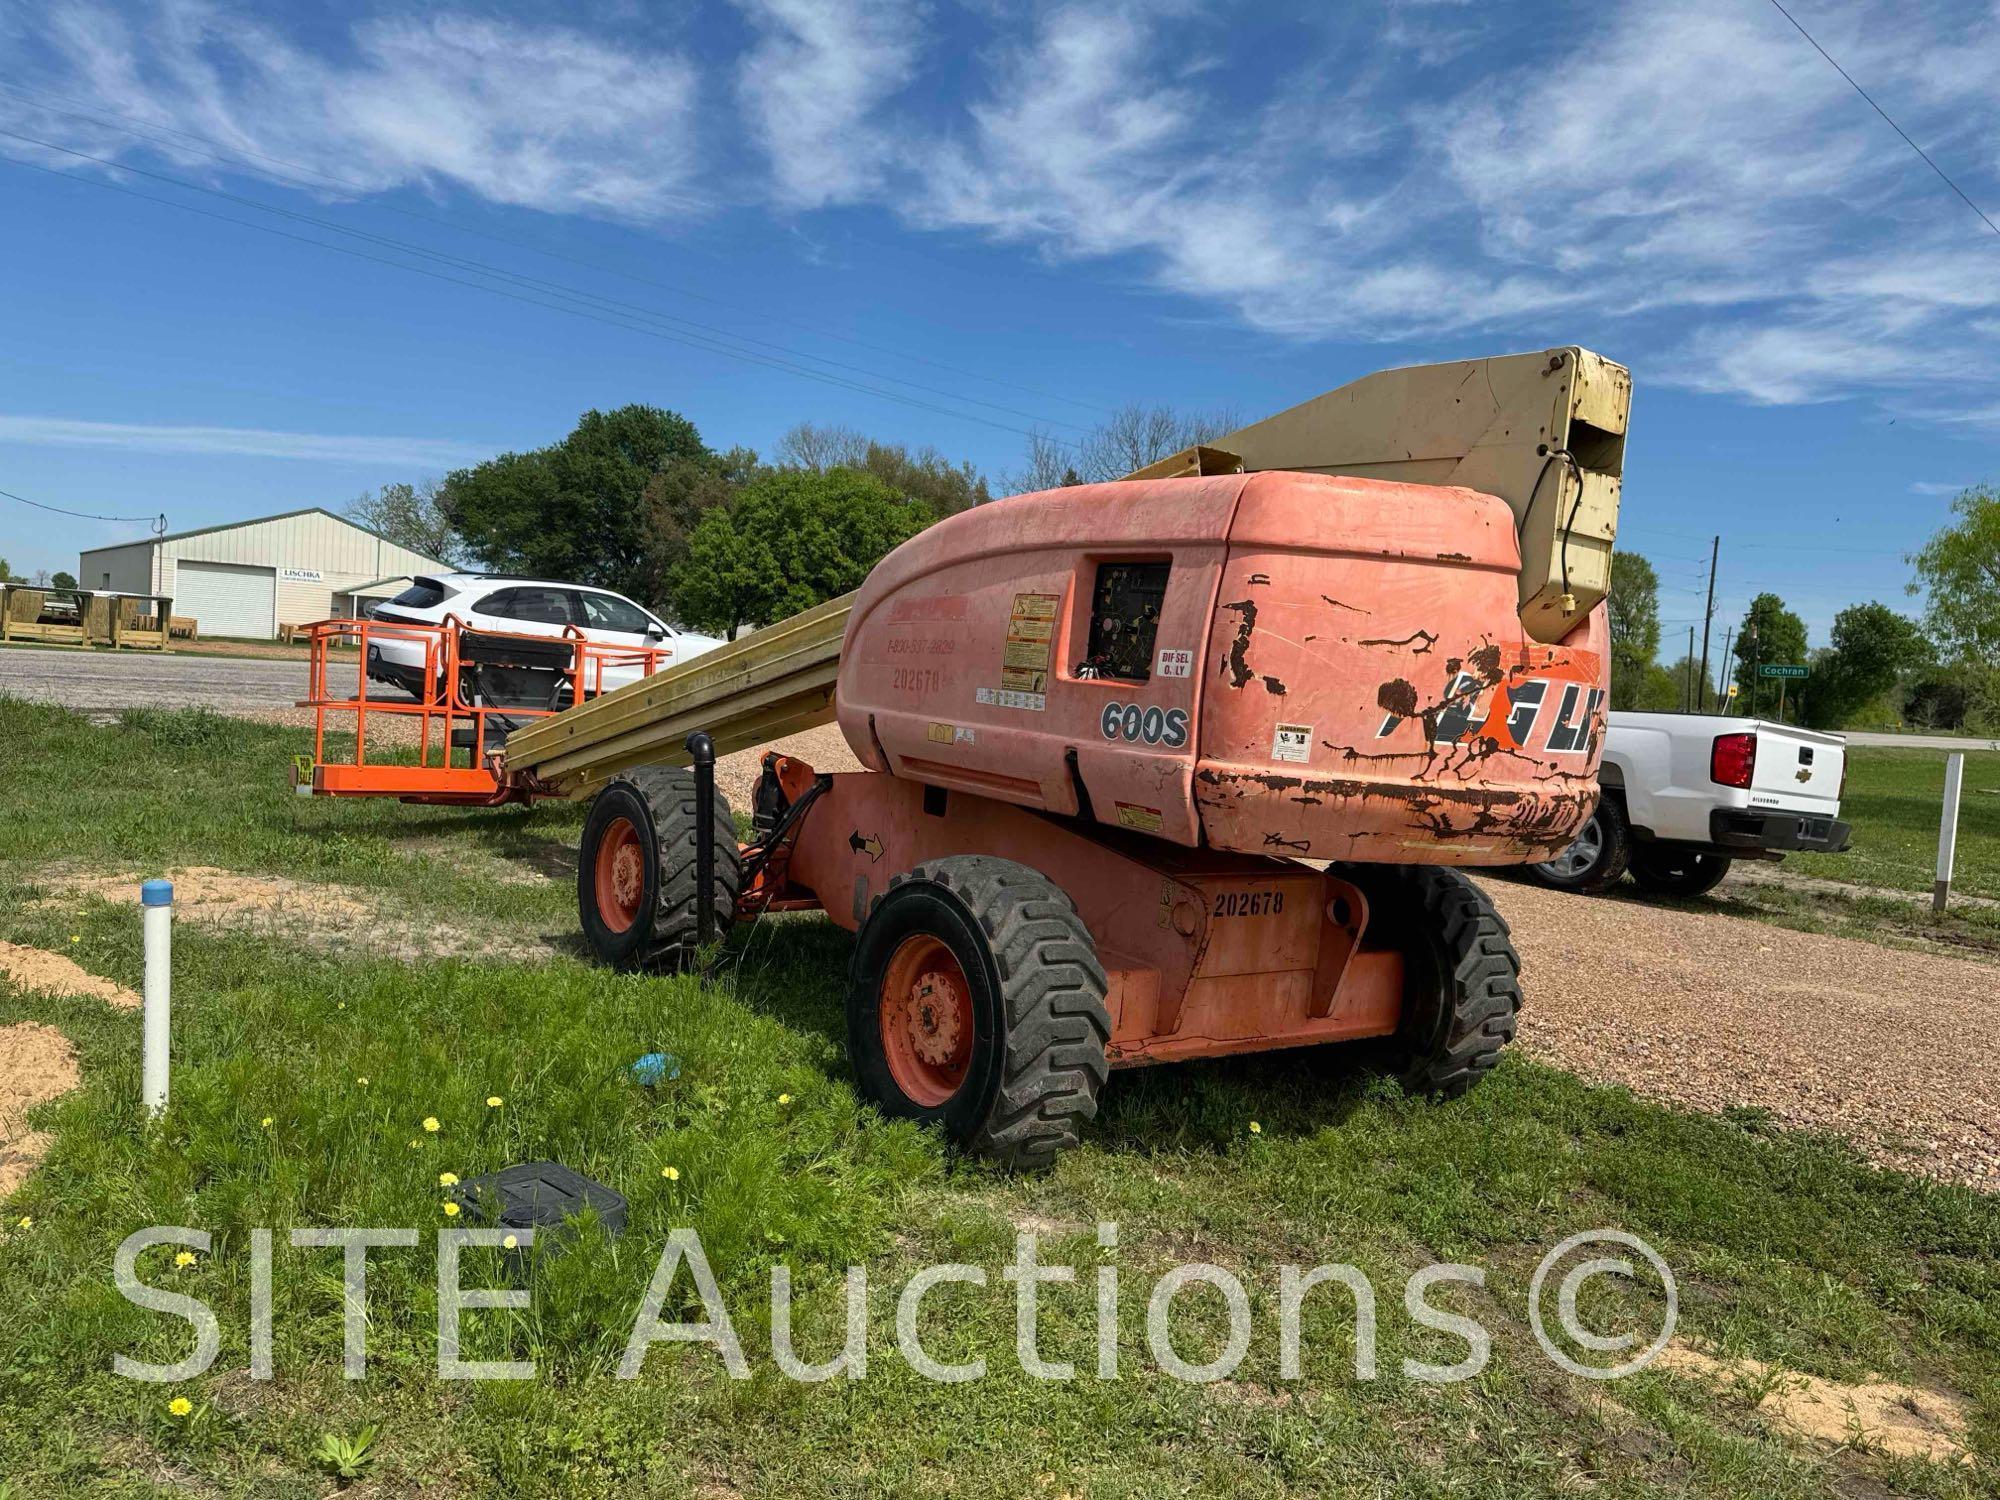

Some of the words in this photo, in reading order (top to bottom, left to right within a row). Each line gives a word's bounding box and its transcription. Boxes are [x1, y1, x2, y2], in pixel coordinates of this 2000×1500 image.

[284, 569, 320, 579] LISCHKA
[893, 667, 940, 693] 202678
[1764, 667, 1805, 676] Cochran
[1101, 701, 1189, 748] 600S
[1214, 891, 1284, 918] 202678
